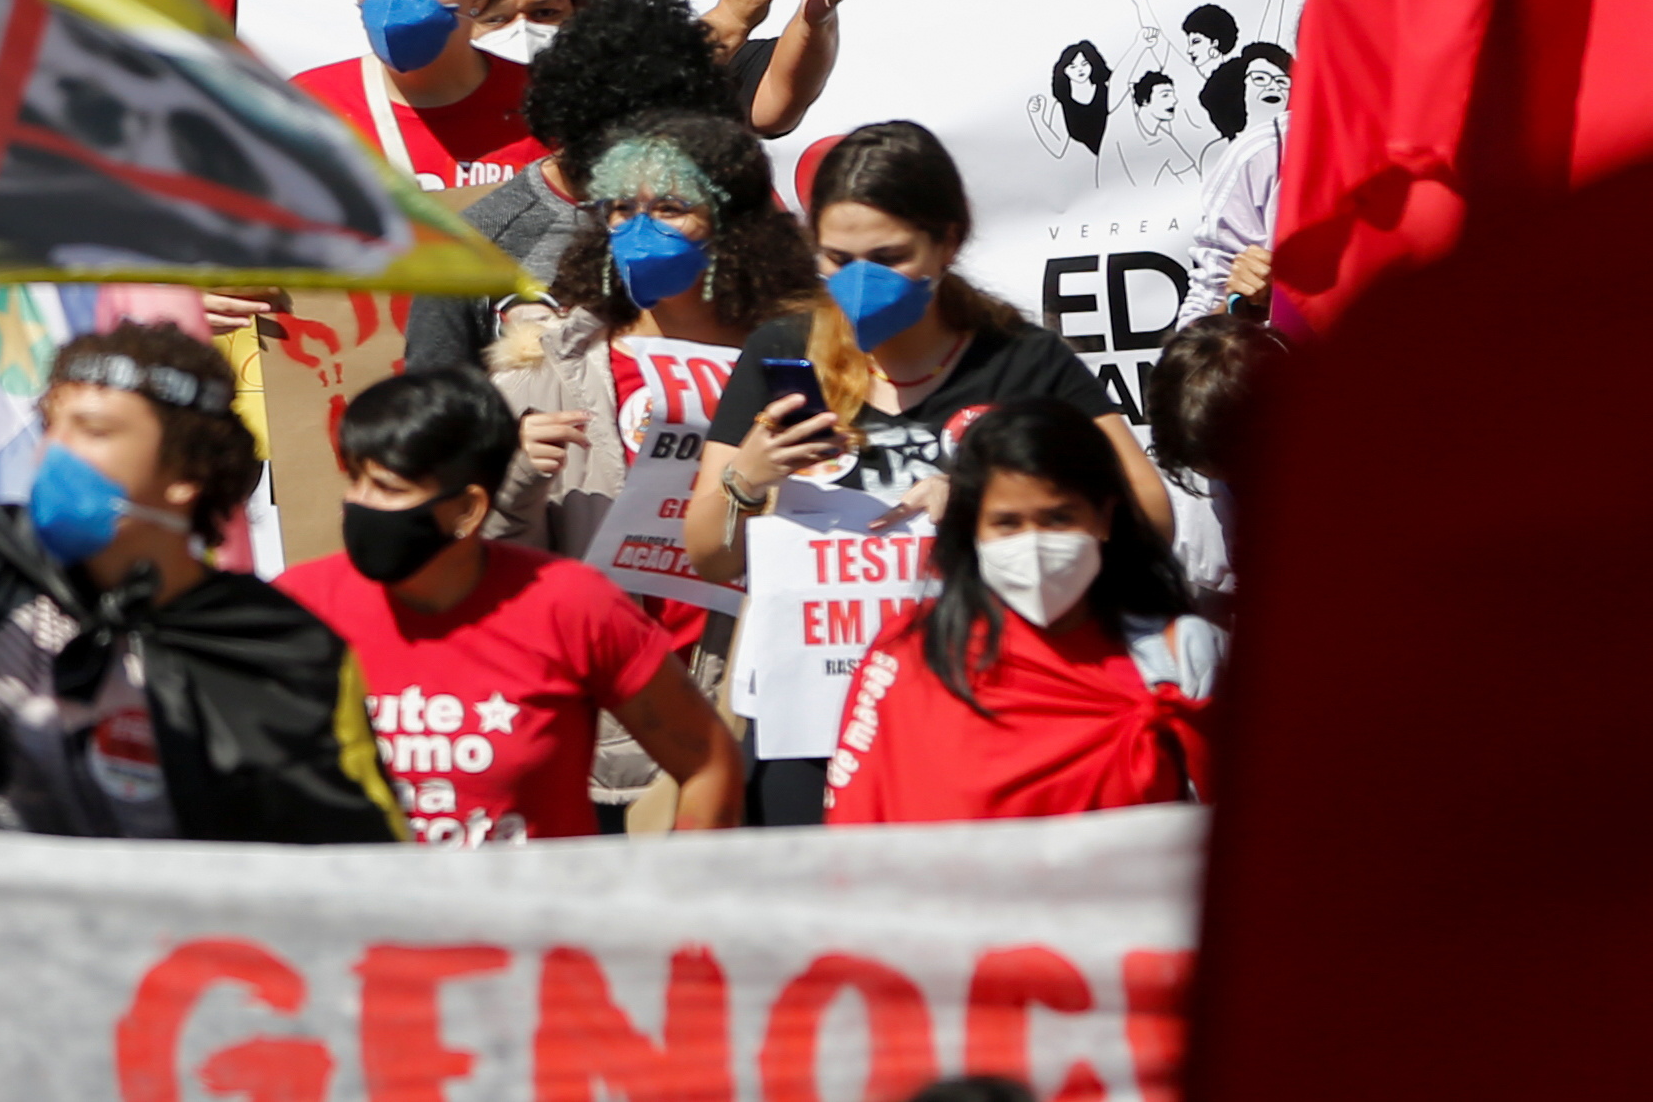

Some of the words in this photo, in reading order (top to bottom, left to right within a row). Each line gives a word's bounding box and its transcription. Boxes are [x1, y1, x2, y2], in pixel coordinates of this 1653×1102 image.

[455, 161, 515, 188] FORA
[1043, 251, 1195, 353] ED
[648, 354, 738, 425] FO
[651, 432, 701, 461] BO
[618, 544, 674, 568] AÇÃO
[803, 600, 865, 645] EM
